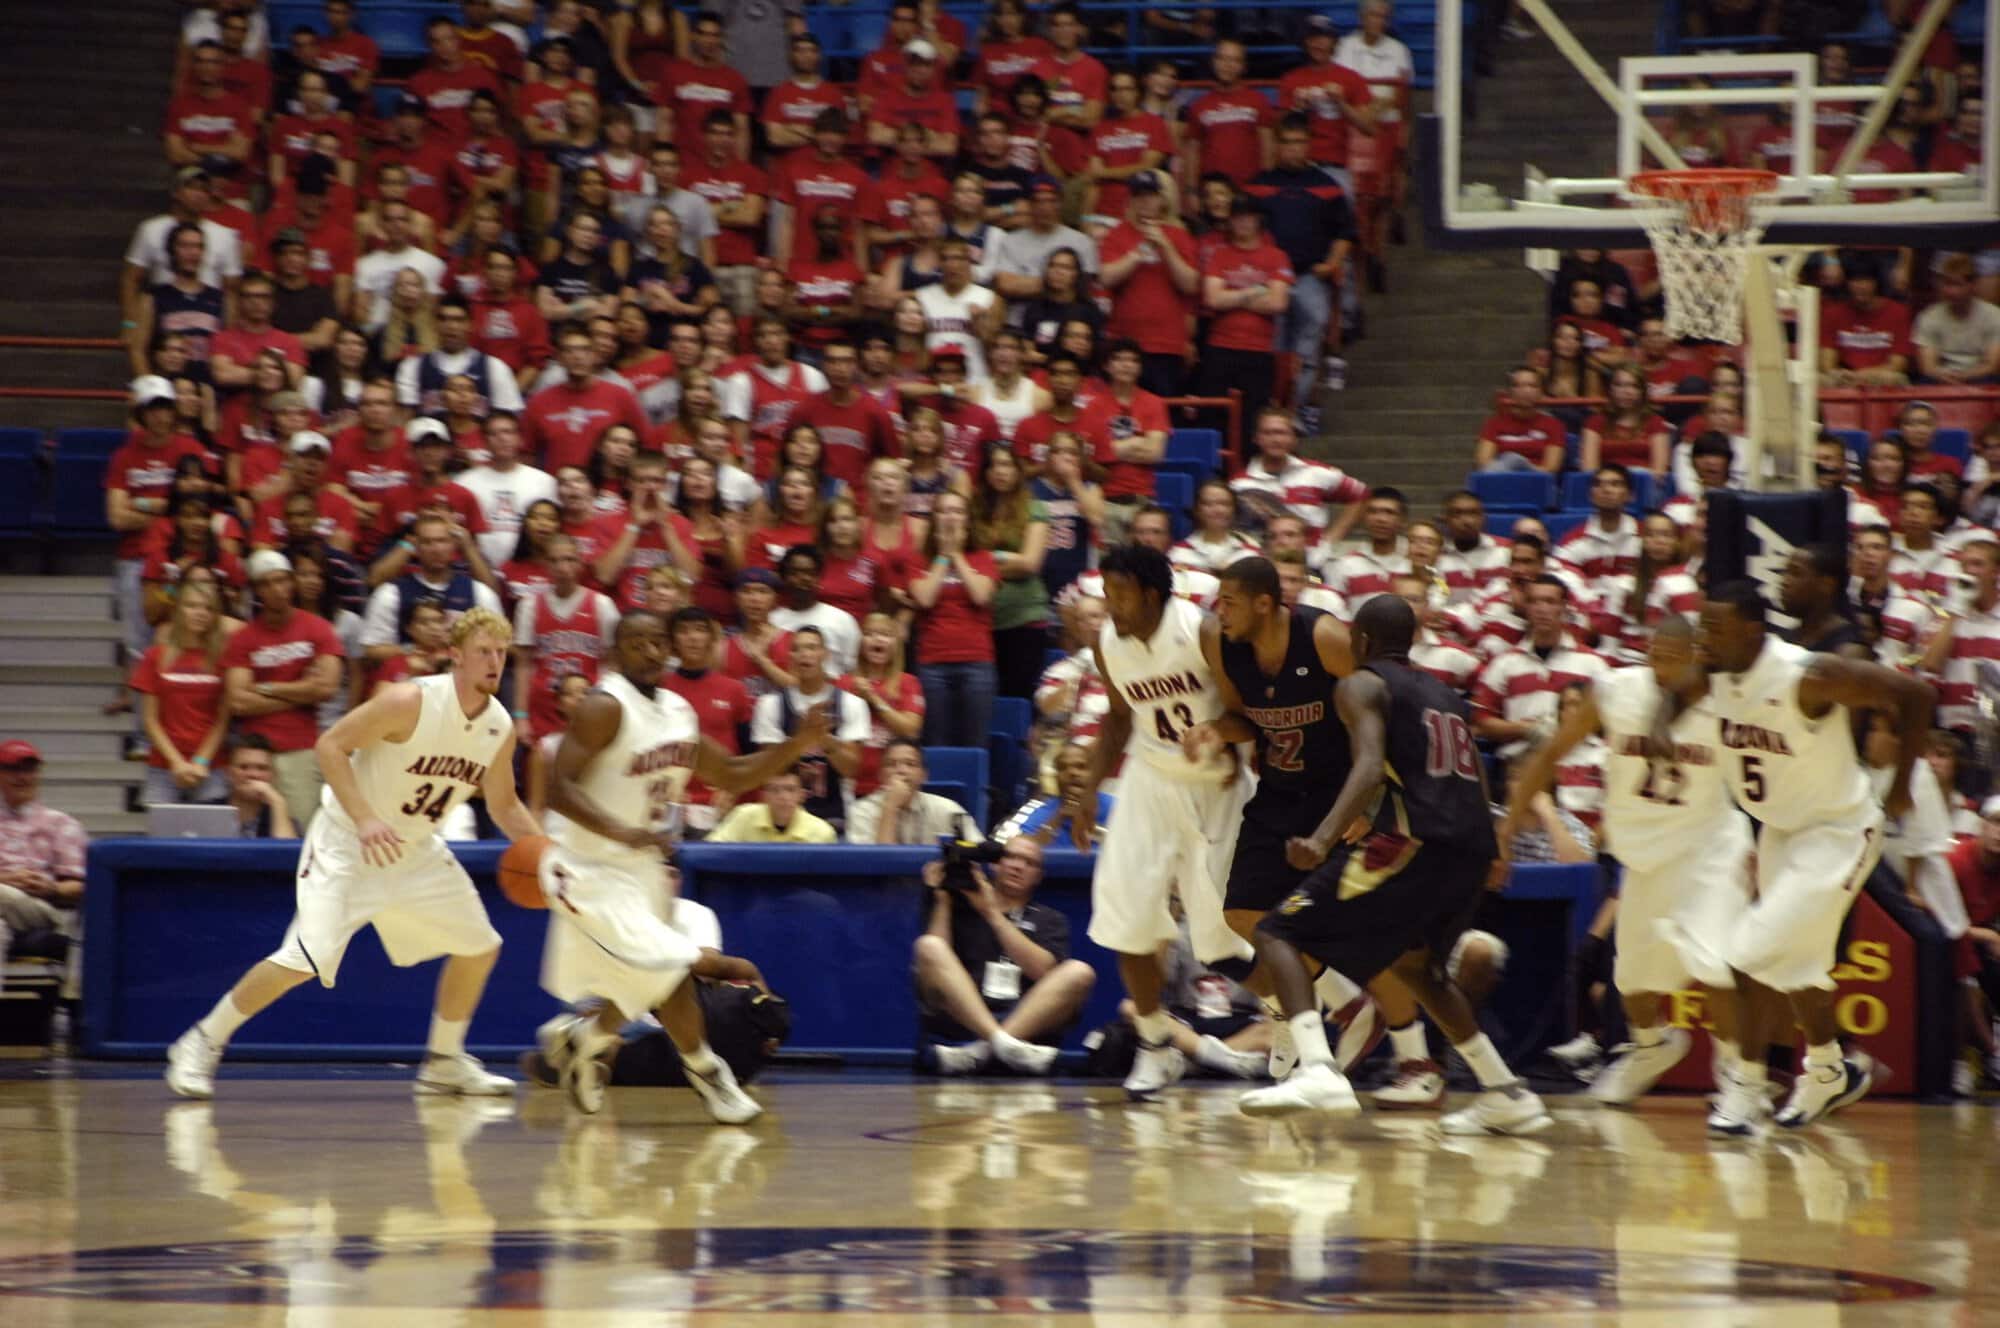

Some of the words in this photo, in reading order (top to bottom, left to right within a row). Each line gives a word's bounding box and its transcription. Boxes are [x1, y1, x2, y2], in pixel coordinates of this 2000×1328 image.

[1124, 670, 1203, 702] ARIZONA
[1422, 706, 1479, 781] 18
[1740, 755, 1766, 803] 5
[401, 781, 455, 823] 34
